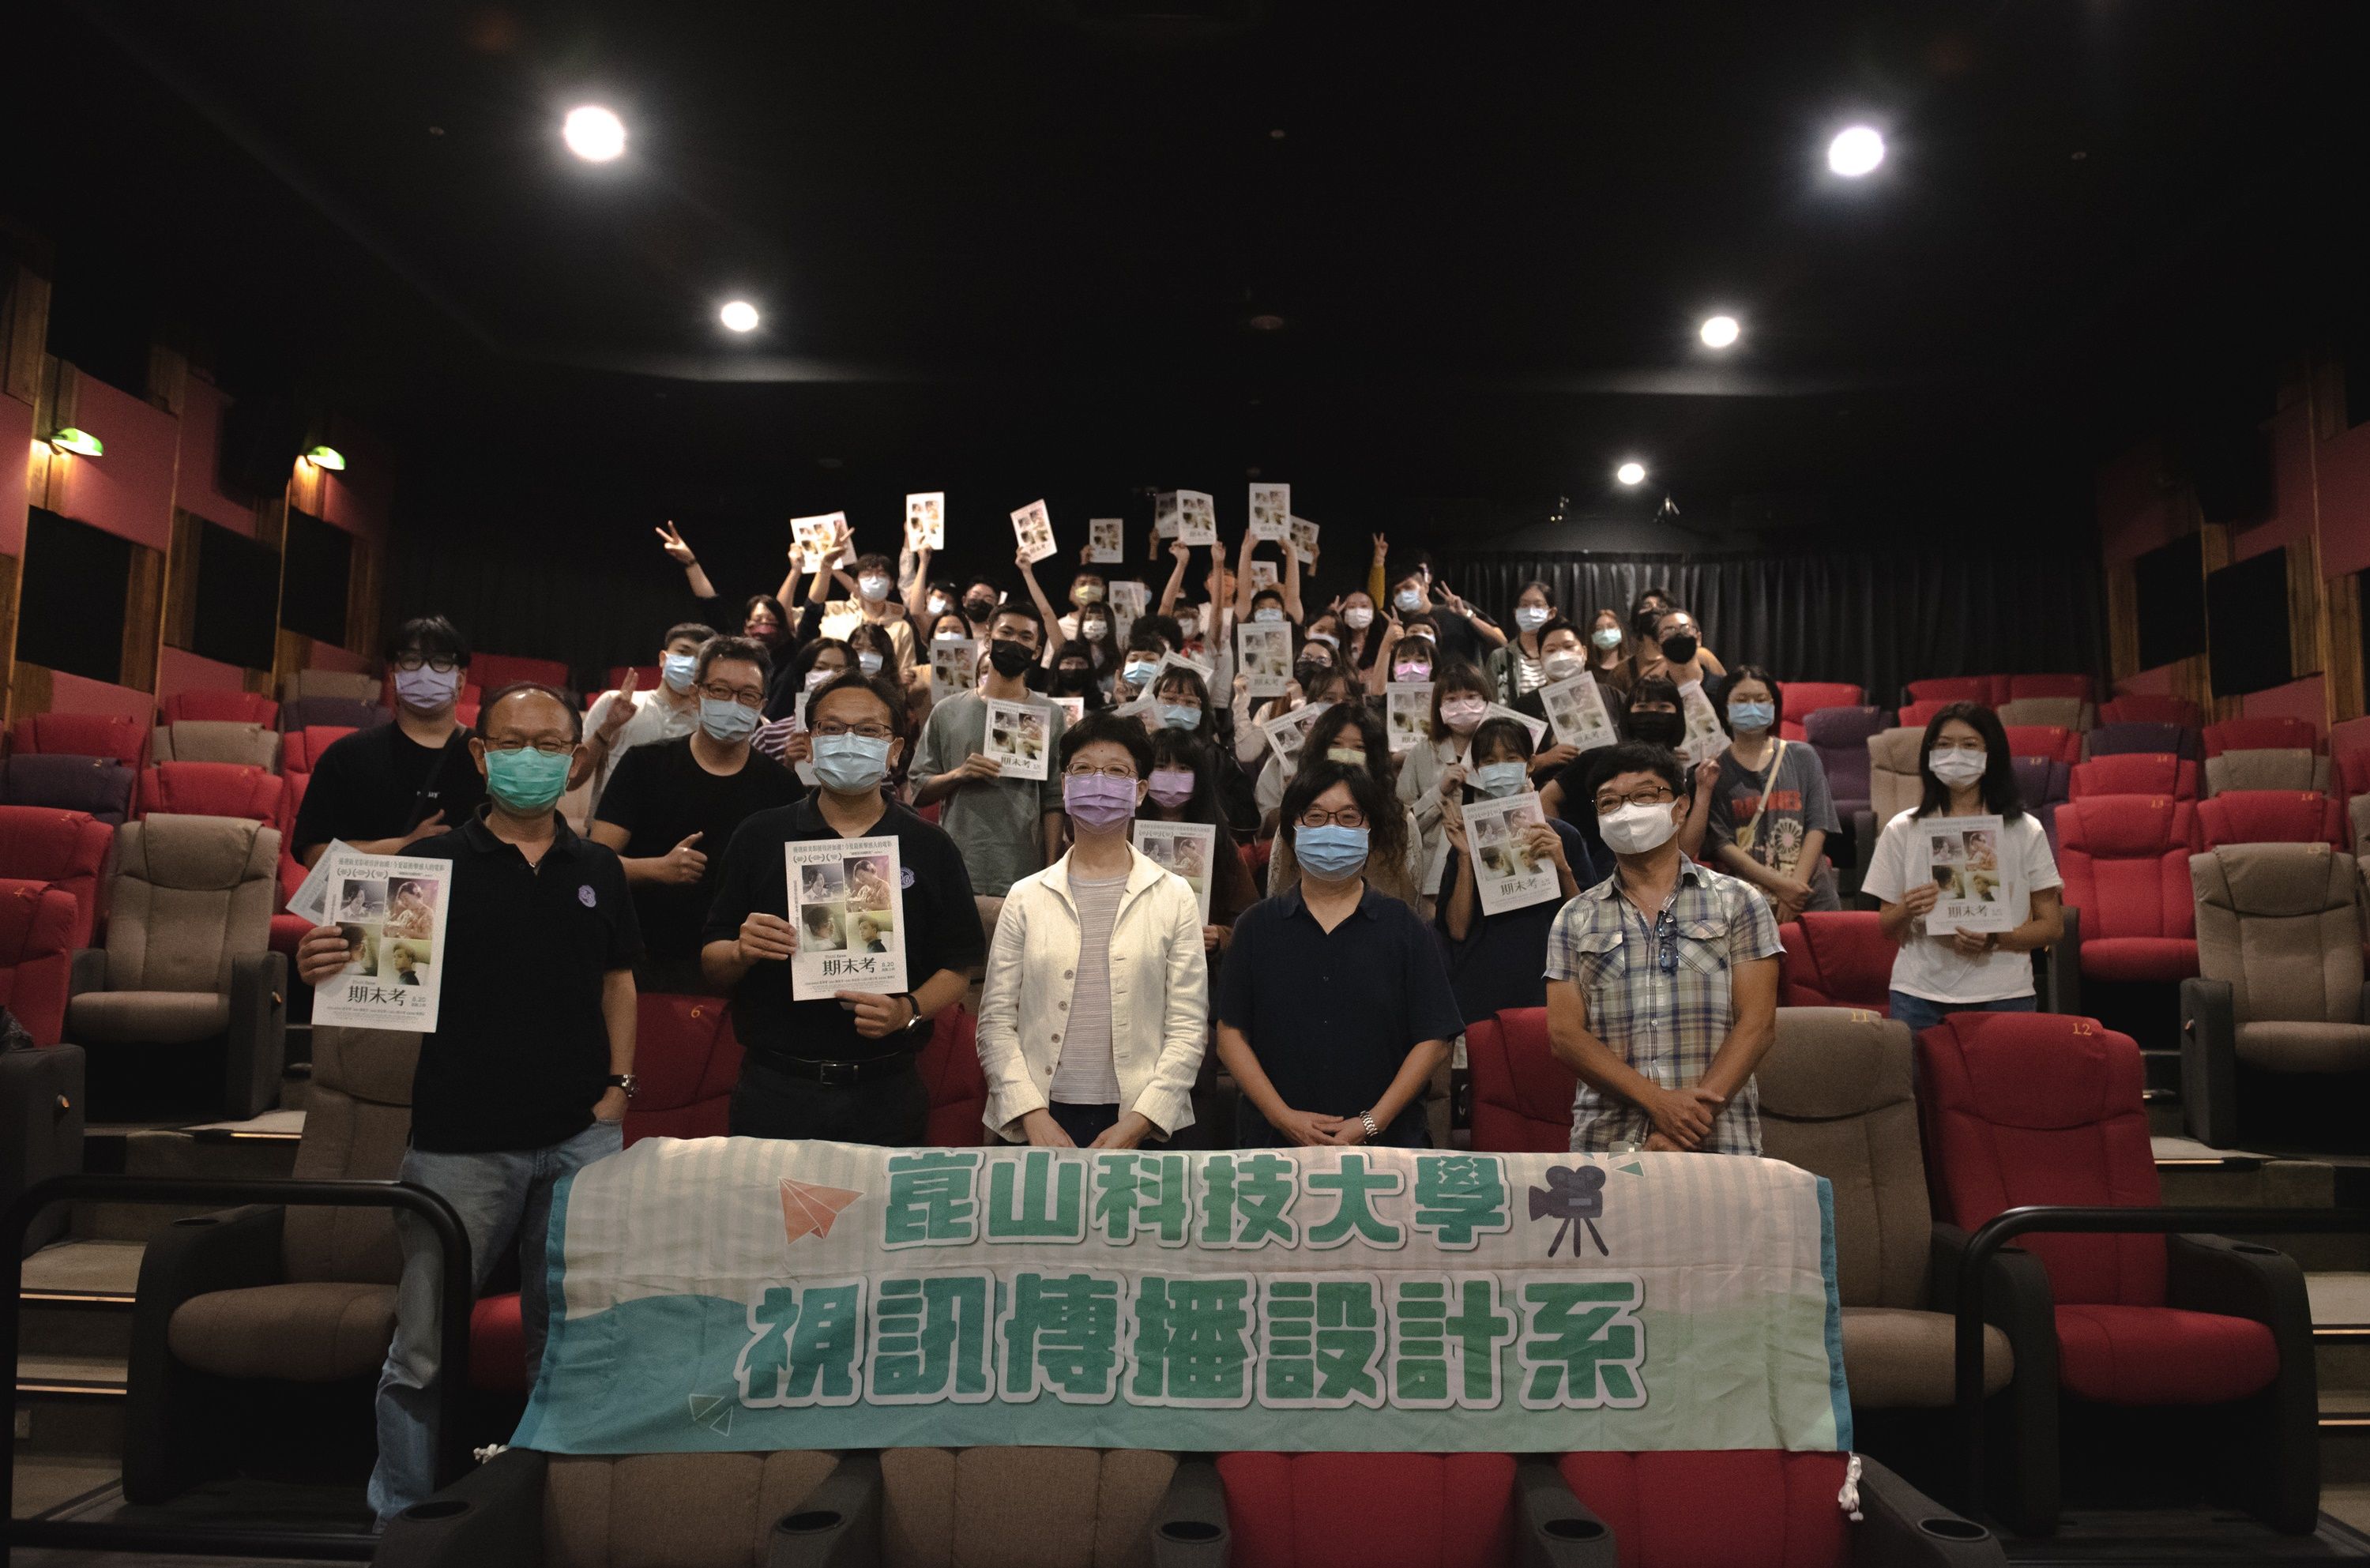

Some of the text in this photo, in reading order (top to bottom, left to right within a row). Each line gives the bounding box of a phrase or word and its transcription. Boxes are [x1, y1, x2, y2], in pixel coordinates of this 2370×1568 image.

[1001, 756, 1031, 769] 期末考
[1501, 878, 1538, 896] 期末考
[1947, 904, 1987, 918] 期末考
[822, 957, 877, 976] 期末考
[348, 985, 408, 1007] 期末考
[690, 1005, 704, 1018] 6
[1851, 1010, 1870, 1023] 11
[2072, 1022, 2093, 1036] 12
[882, 1150, 1508, 1247] 崑山科技大學
[738, 1270, 1642, 1404] 視訊傳播設計系
